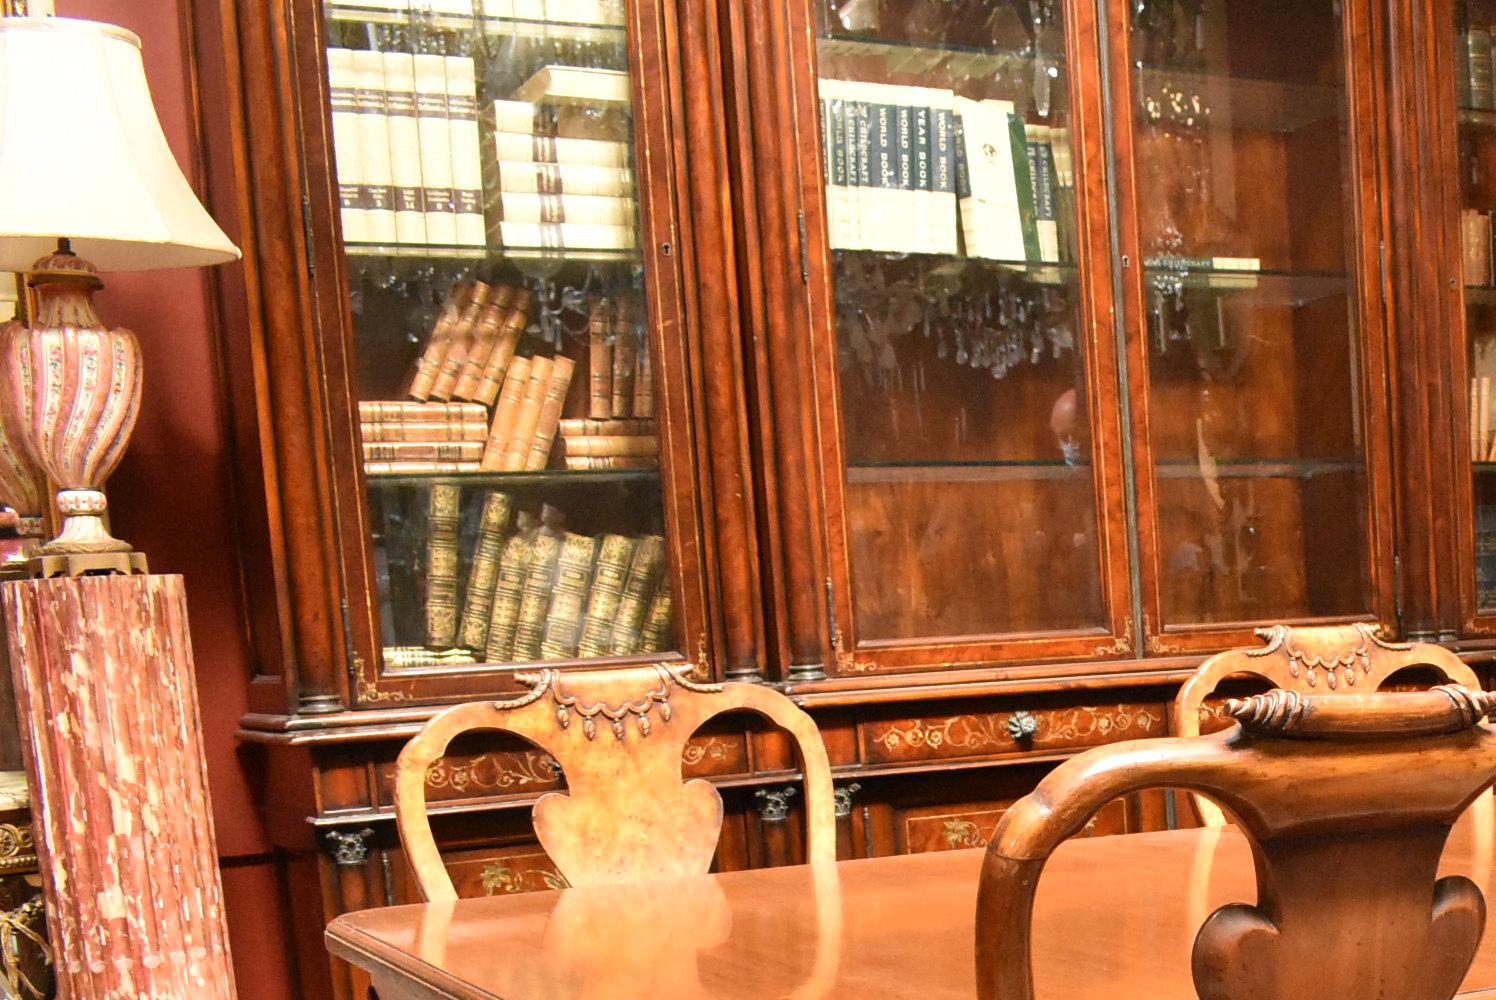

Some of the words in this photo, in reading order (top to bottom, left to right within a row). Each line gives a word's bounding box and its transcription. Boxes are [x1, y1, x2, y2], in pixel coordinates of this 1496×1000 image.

[835, 106, 843, 144] ORLD
[880, 108, 888, 148] WORLD
[901, 109, 909, 149] WORLD
[918, 110, 926, 145] YEAR
[938, 112, 947, 152] WORLD
[880, 152, 889, 187] BOOK
[901, 154, 910, 187] BOOK
[919, 152, 927, 187] BOOK
[939, 156, 947, 188] BOOK
